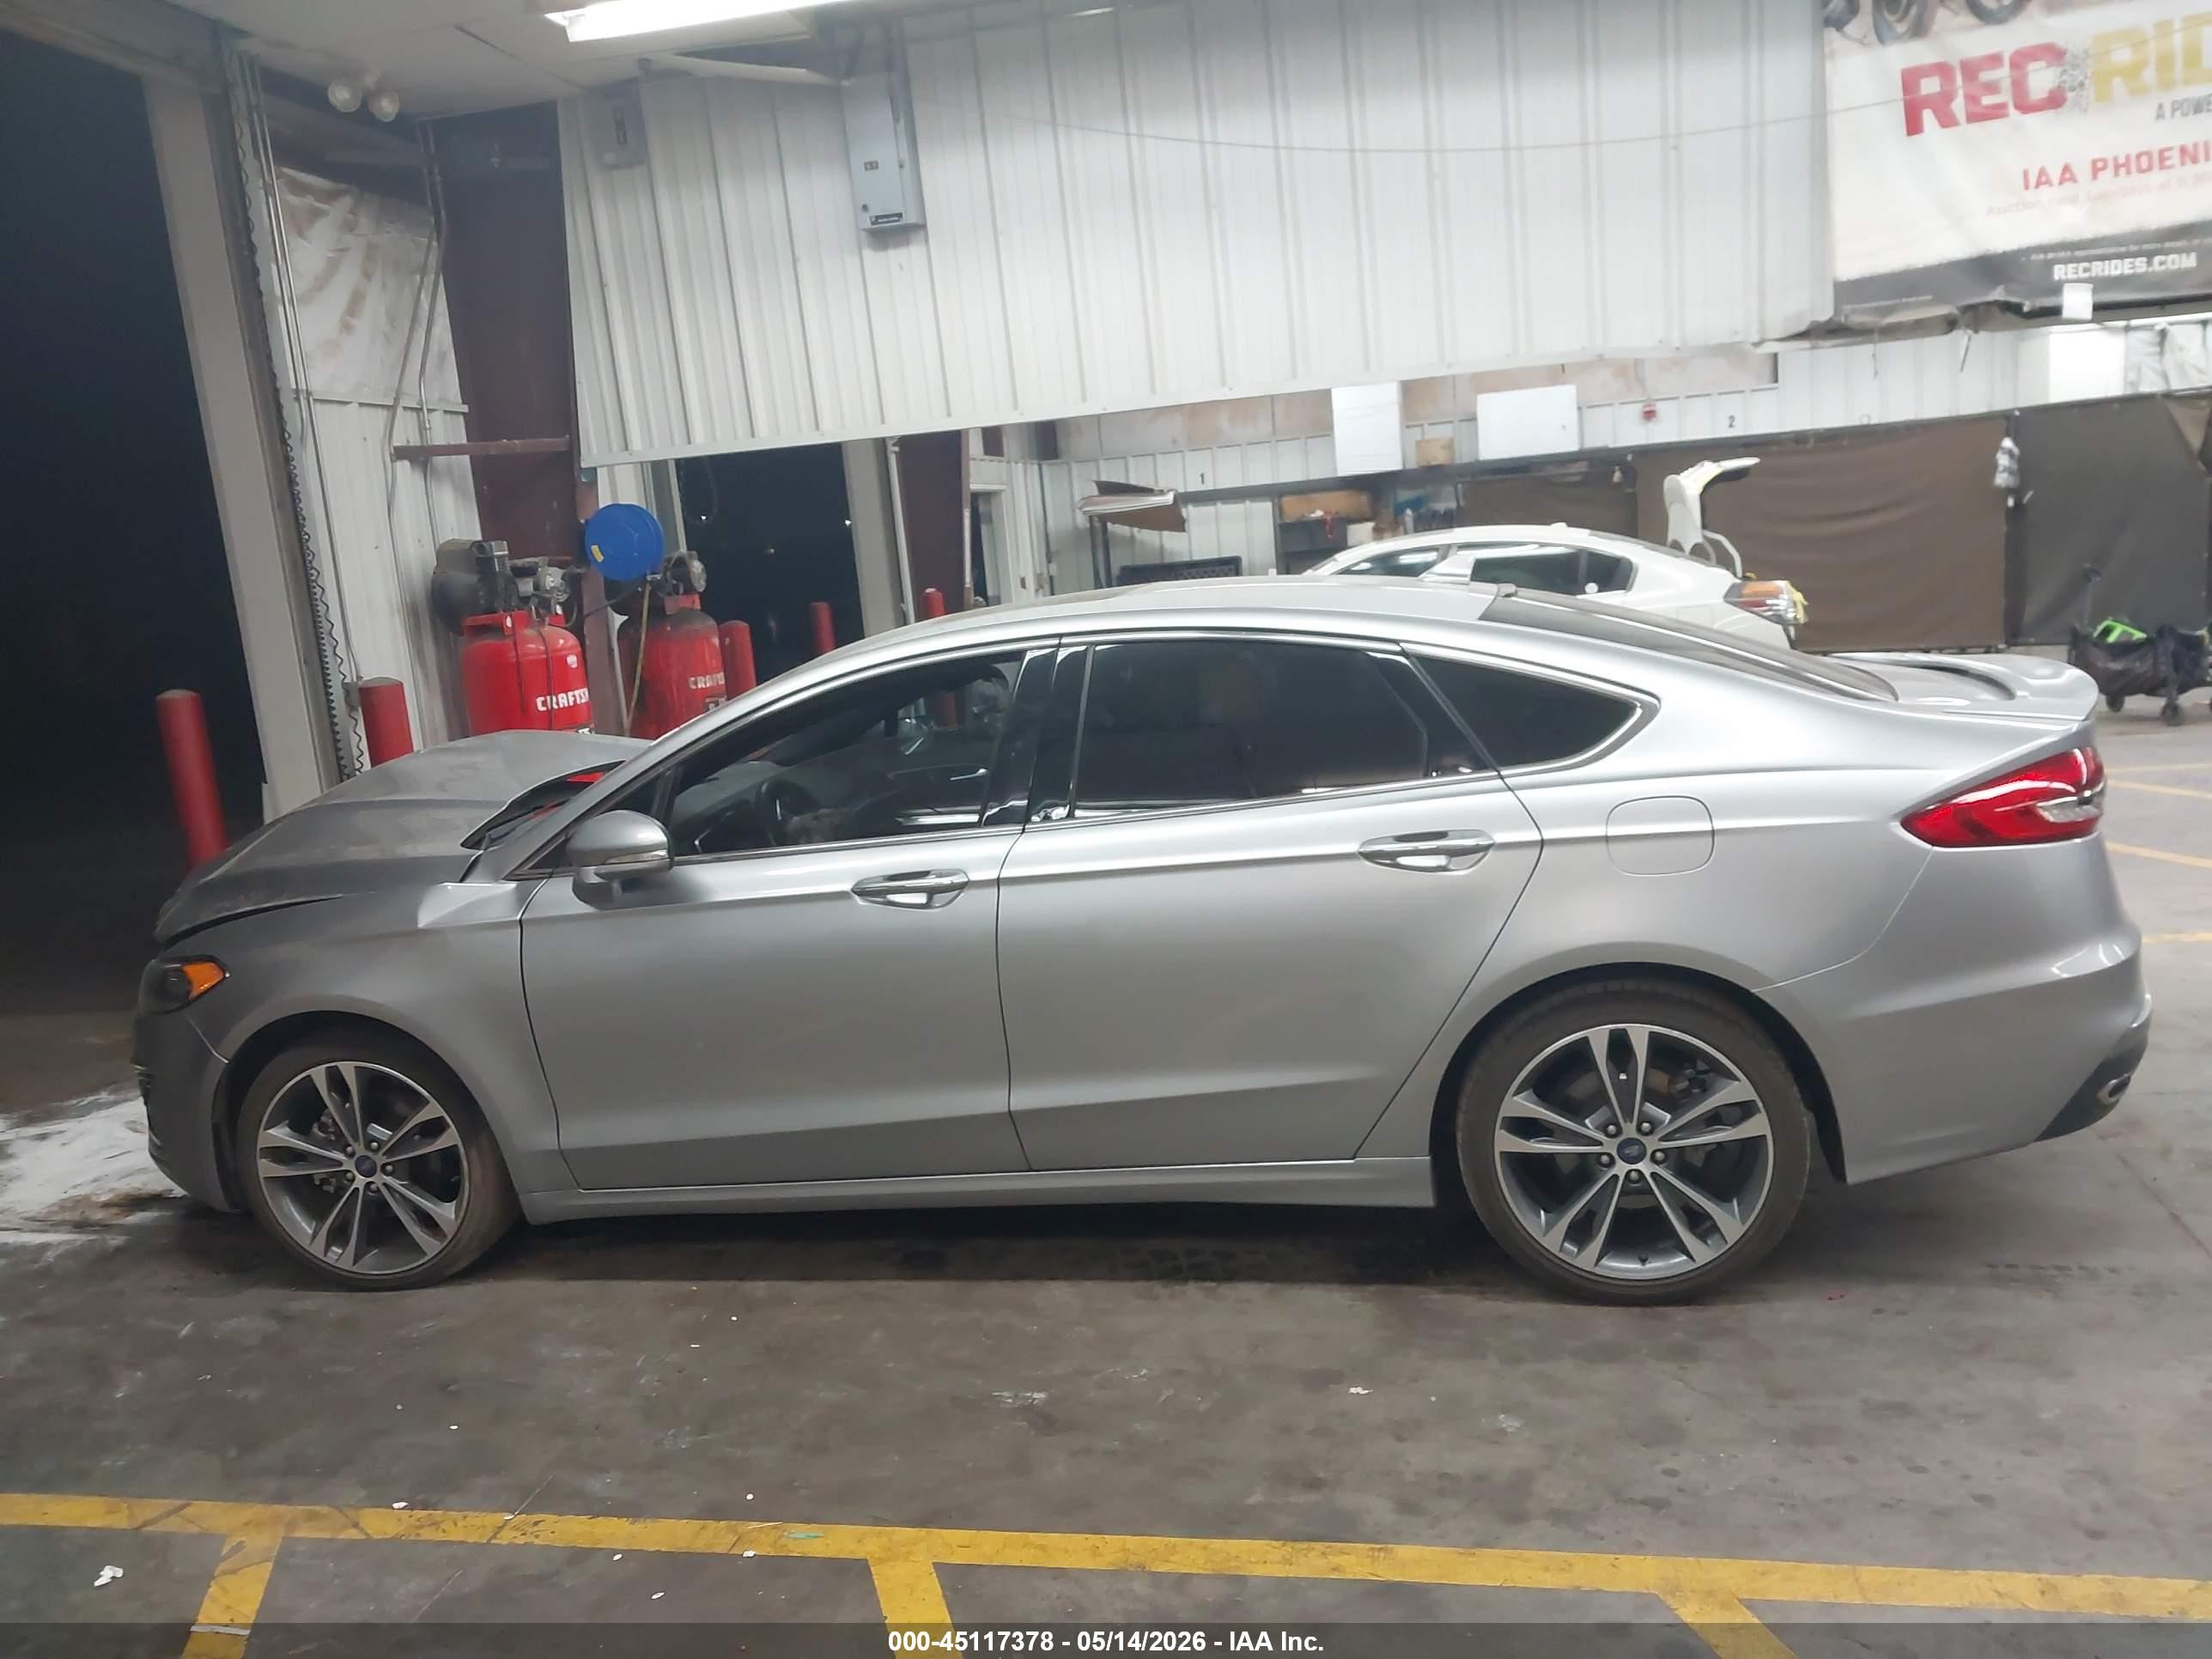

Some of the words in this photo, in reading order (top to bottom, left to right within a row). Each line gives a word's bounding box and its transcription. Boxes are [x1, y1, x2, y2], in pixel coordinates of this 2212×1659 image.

[1900, 41, 2069, 137] REC
[2022, 161, 2079, 191] IAA
[2053, 252, 2198, 282] RECRIDES.COM
[1728, 414, 1736, 428] 2
